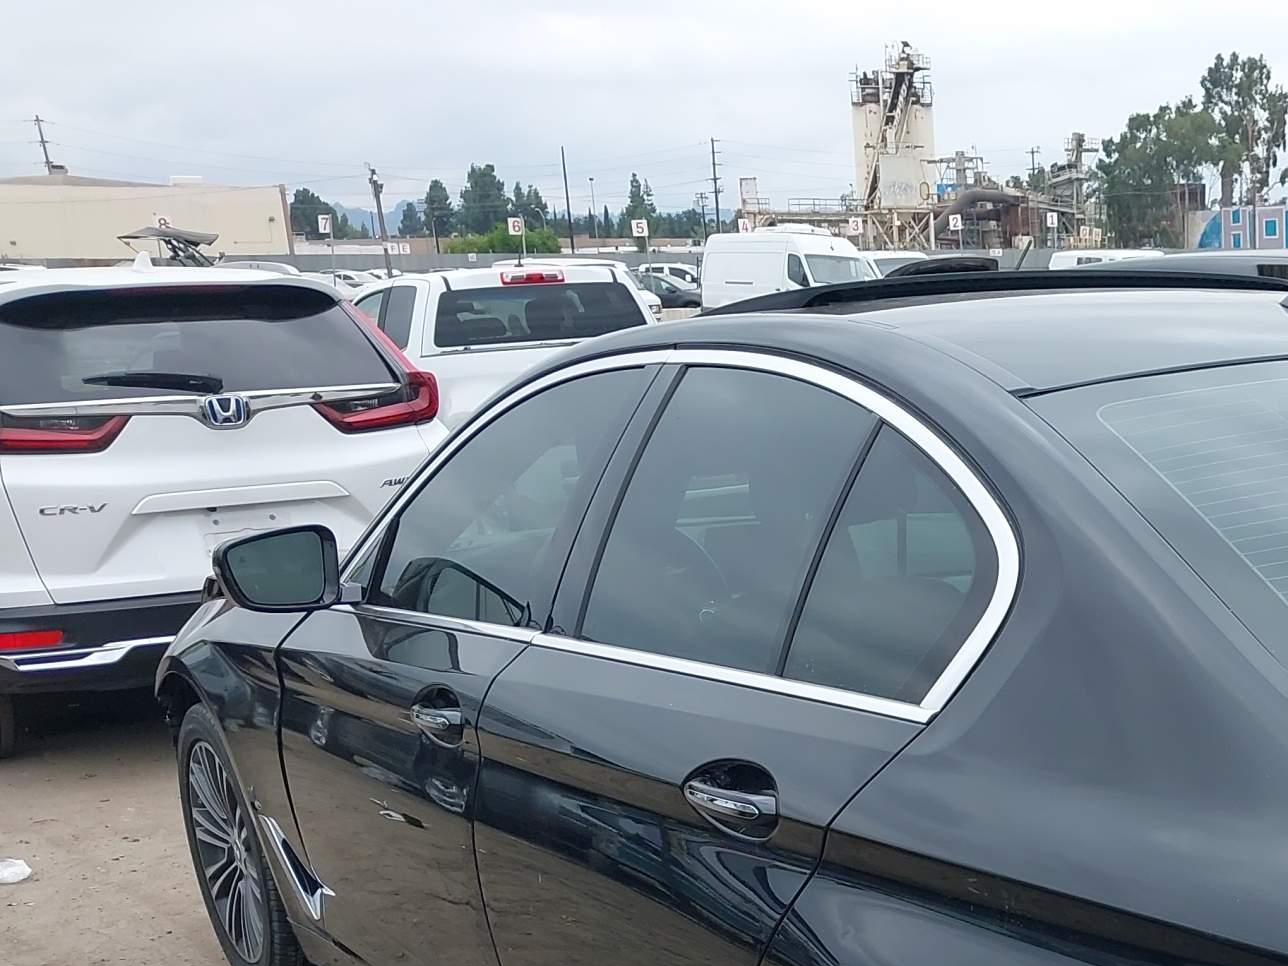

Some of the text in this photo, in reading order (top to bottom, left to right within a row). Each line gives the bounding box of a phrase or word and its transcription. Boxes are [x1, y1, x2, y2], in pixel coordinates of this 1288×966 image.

[320, 217, 329, 231] 7
[512, 219, 521, 232] 6
[636, 222, 645, 234] 5
[852, 219, 860, 231] 3
[952, 217, 959, 229] 2
[379, 476, 410, 488] AW
[39, 502, 110, 517] CR-V
